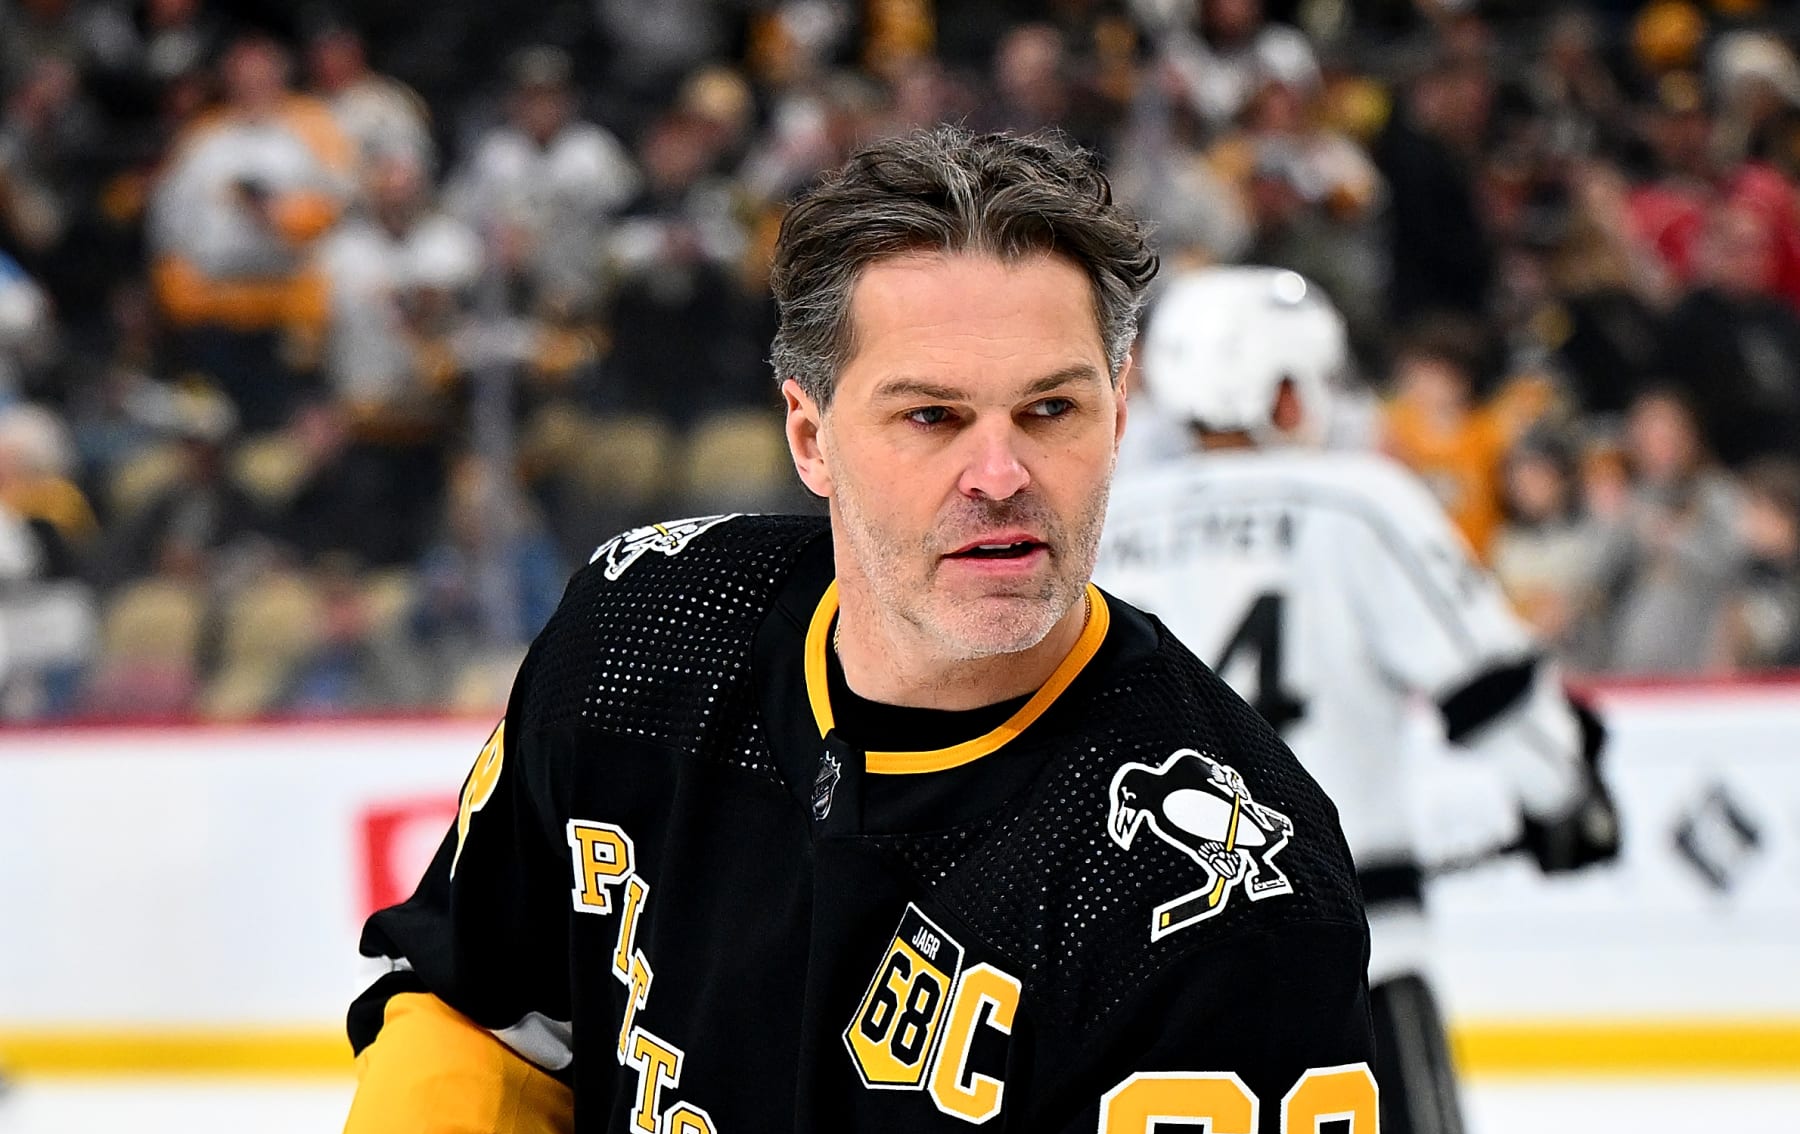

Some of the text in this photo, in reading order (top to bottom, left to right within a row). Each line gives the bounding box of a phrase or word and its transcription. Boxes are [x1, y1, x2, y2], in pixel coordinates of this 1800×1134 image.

[911, 926, 941, 961] JAGR
[860, 948, 943, 1069] 68
[926, 961, 1022, 1125] C
